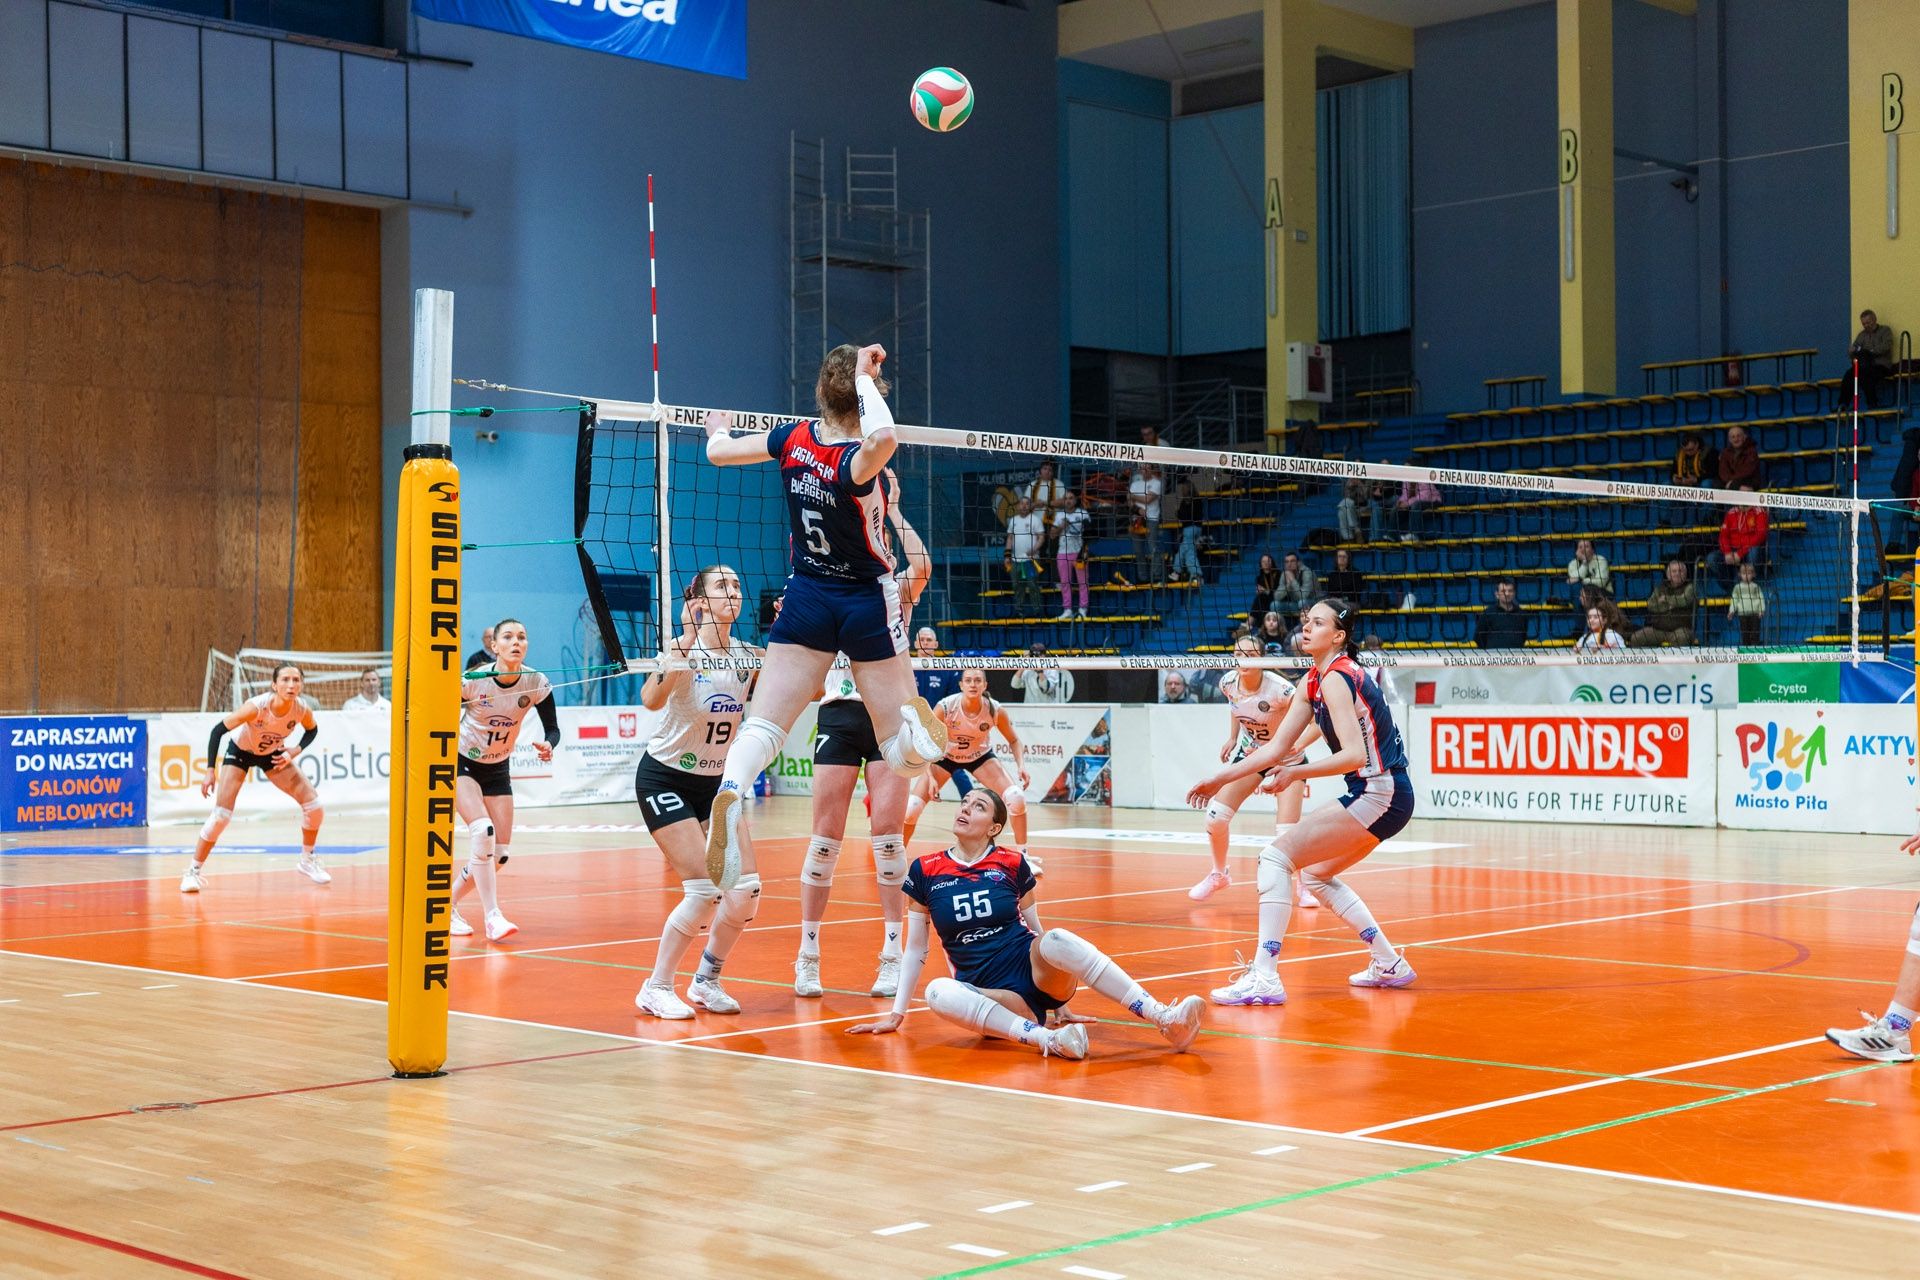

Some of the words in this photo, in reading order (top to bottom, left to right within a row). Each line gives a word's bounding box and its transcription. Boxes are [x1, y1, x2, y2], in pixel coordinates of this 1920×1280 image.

[1881, 72, 1903, 133] B
[1560, 129, 1578, 183] B
[1264, 178, 1284, 229] A
[981, 434, 1013, 450] ENEA
[1017, 437, 1048, 453] KLUB
[1051, 439, 1117, 459] SIATKARSKI
[1120, 446, 1144, 461] PIŁA
[1231, 454, 1258, 469] ENEA
[1261, 457, 1287, 471] KLUB
[1289, 459, 1344, 475] SIATKARSKI
[1347, 464, 1367, 477] PIŁA
[1440, 471, 1462, 483] ENEA
[1464, 473, 1486, 485] KLUB
[1488, 474, 1535, 489] SIATKARSKI
[1537, 478, 1554, 490] PIŁA
[1616, 484, 1635, 495] ENEA
[1637, 485, 1656, 497] KLUB
[1658, 487, 1697, 499] SIATKARSKI
[1699, 490, 1714, 501] PIŁA
[801, 508, 831, 556] 5
[430, 511, 459, 671] SPORT
[702, 658, 732, 670] ENEA
[734, 658, 763, 670] KLUB
[932, 658, 958, 669] ENEA
[960, 658, 985, 669] KLUB
[986, 658, 1038, 669] SIATKARSKI
[1040, 658, 1060, 669] PIŁA
[1130, 658, 1153, 668] ENEA
[1153, 658, 1175, 668] KLUB
[1176, 658, 1222, 668] SIATKARSKI
[1223, 658, 1240, 668] PIŁA
[1382, 658, 1398, 667] PIŁA
[1451, 686, 1490, 700] Polska
[1609, 674, 1714, 704] eneris
[1768, 683, 1807, 697] Czysta
[710, 701, 743, 713] Enea
[11, 727, 137, 746] ZAPRASZAMY
[486, 730, 510, 746] 14
[706, 721, 732, 745] 19
[16, 754, 46, 772] DO
[49, 751, 134, 771] NASZYCH
[29, 775, 121, 797] SALONÓW
[1749, 762, 1803, 792] 500
[646, 792, 685, 816] 19
[1431, 789, 1518, 809] WORKING
[1528, 792, 1561, 810] FOR
[1569, 793, 1603, 811] THE
[1613, 794, 1687, 813] FUTURE
[1735, 794, 1789, 809] Miasto
[1796, 796, 1828, 810] Piła
[17, 802, 133, 823] MEBLOWYCH
[423, 730, 458, 990] TRANSFER
[952, 889, 993, 922] 55
